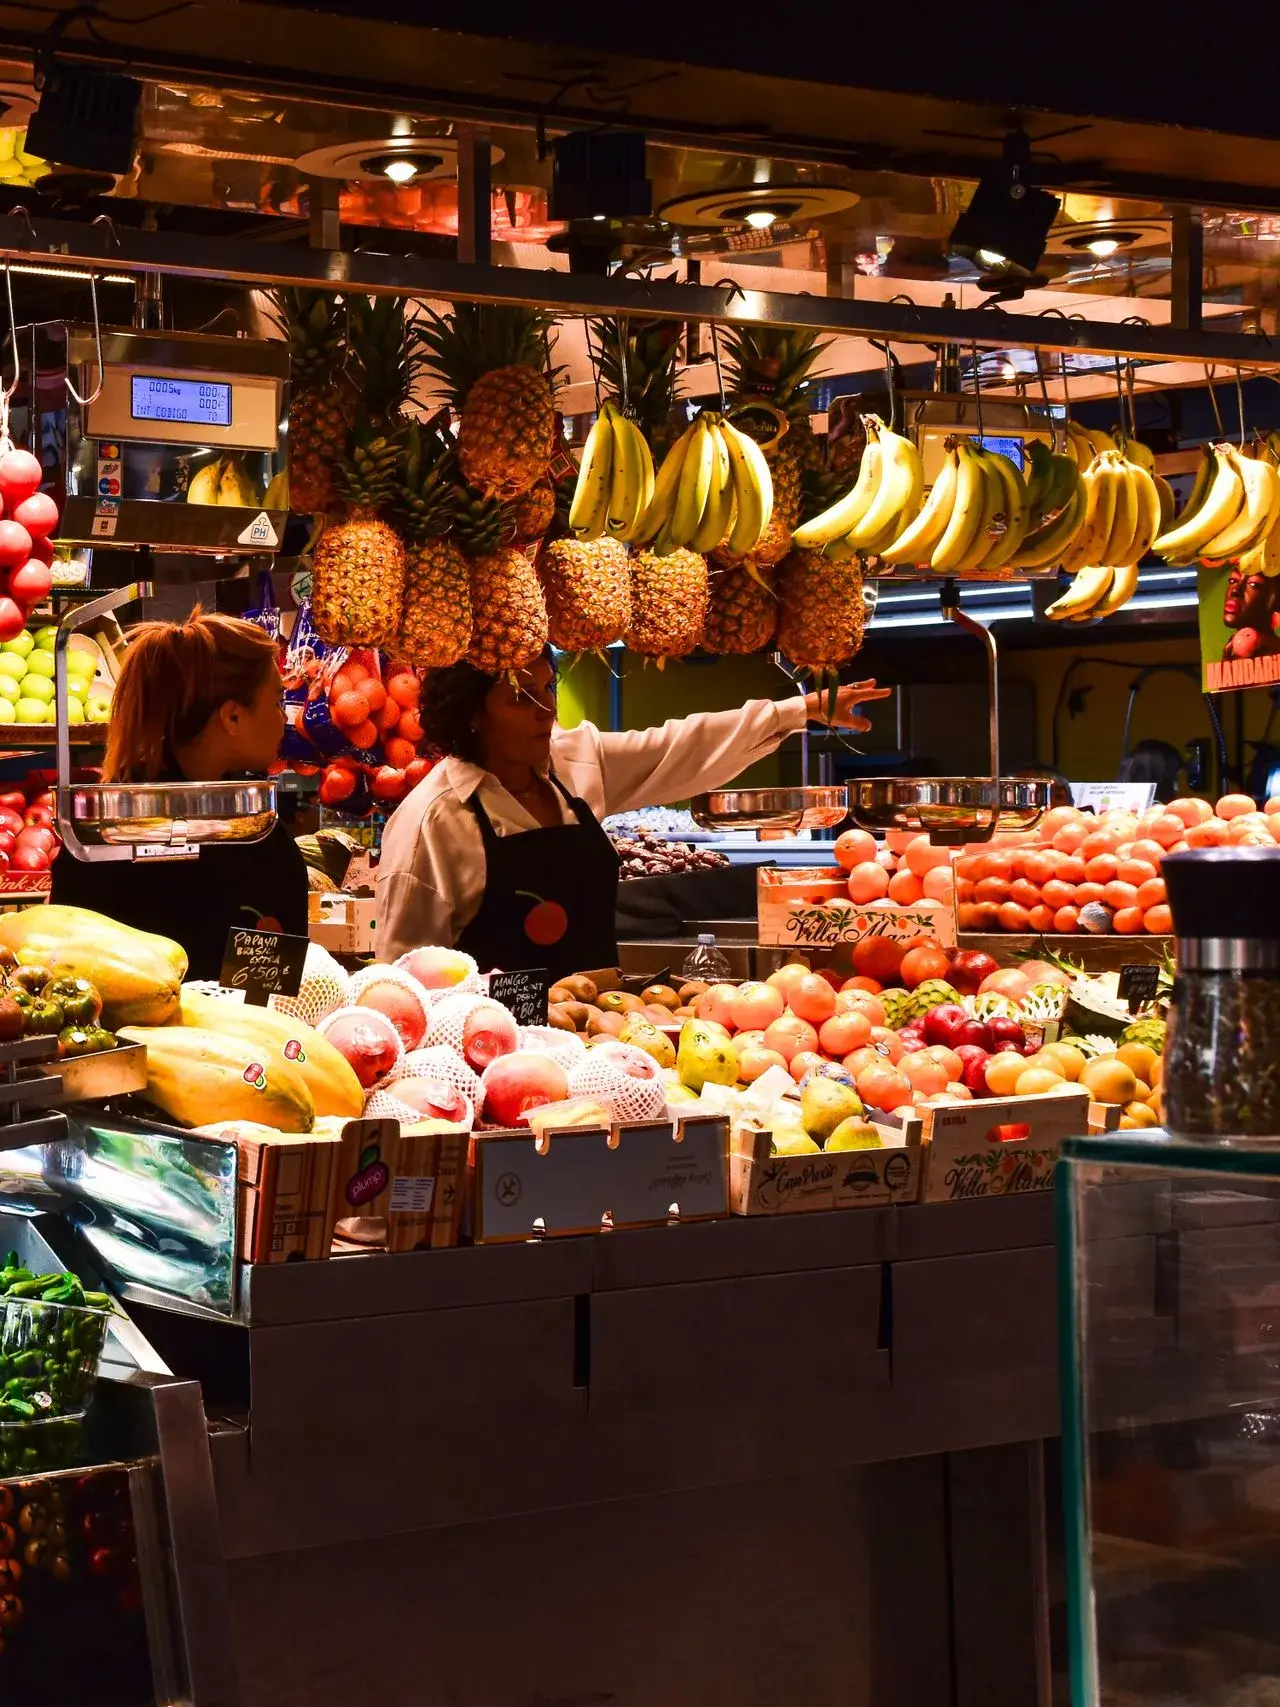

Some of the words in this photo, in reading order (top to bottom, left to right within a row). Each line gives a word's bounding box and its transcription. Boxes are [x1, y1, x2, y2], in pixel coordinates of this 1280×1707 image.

[254, 528, 267, 537] PH
[786, 917, 840, 943] Villa
[234, 932, 278, 948] PAPAYA
[237, 946, 275, 956] BRASIL
[493, 974, 529, 990] MANGO
[352, 1172, 382, 1198] plump
[944, 1167, 988, 1199] Villa
